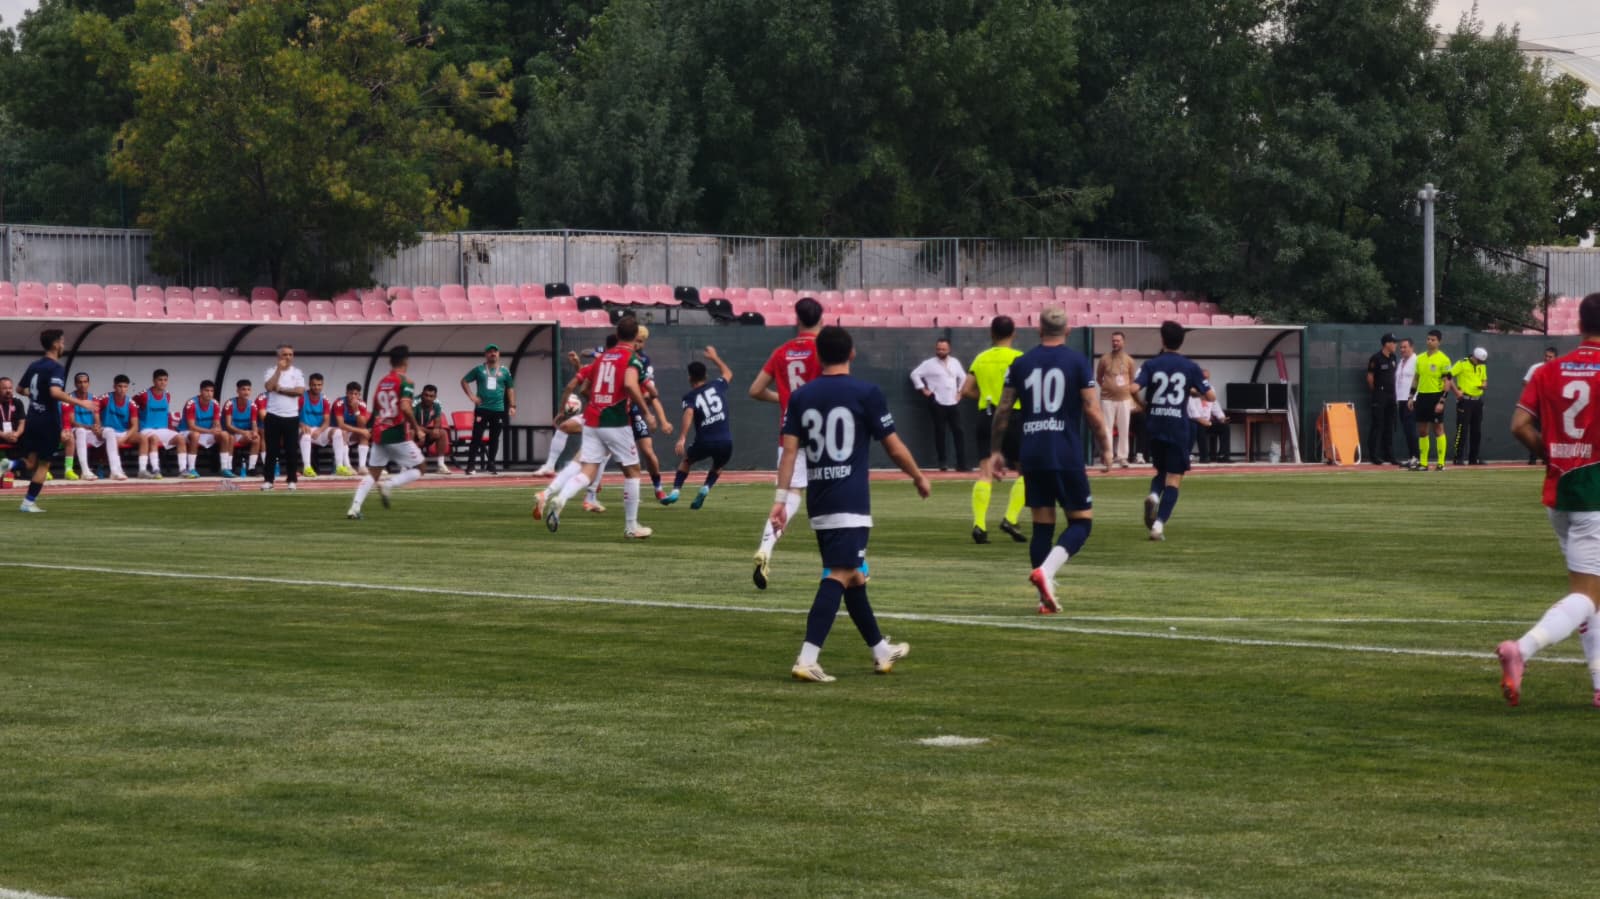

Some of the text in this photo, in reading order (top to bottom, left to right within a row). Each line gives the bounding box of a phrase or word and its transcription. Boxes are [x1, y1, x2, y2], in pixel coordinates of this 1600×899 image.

[30, 373, 39, 401] 4
[594, 361, 616, 393] 14
[1024, 367, 1065, 414] 10
[1151, 371, 1186, 405] 23
[377, 390, 399, 418] 93
[695, 387, 723, 418] 15
[1562, 380, 1591, 439] 2
[801, 406, 856, 463] 30
[824, 465, 852, 480] EVREN
